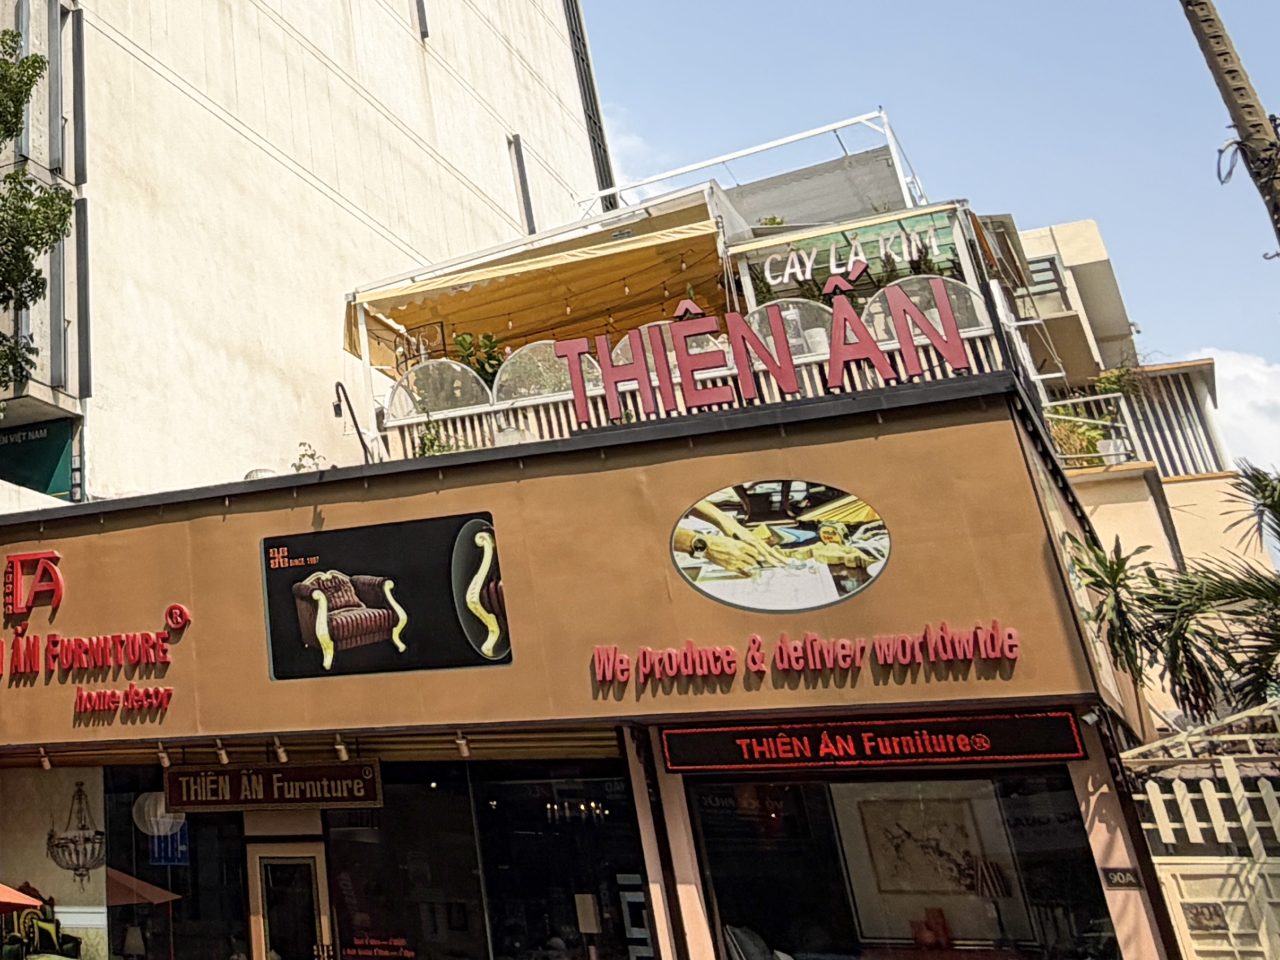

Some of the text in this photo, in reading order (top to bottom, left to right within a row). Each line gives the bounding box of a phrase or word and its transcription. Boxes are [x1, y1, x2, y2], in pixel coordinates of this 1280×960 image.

[764, 243, 817, 286] CÂY
[879, 225, 941, 263] KIM
[555, 260, 970, 424] THIÊN ẤN
[28, 428, 48, 440] NAM
[593, 619, 1021, 684] We produce & deliver worldwide
[75, 682, 174, 713] home decor
[735, 732, 811, 760] THIÊN
[272, 773, 365, 800] Furniture
[1108, 872, 1136, 884] 90A
